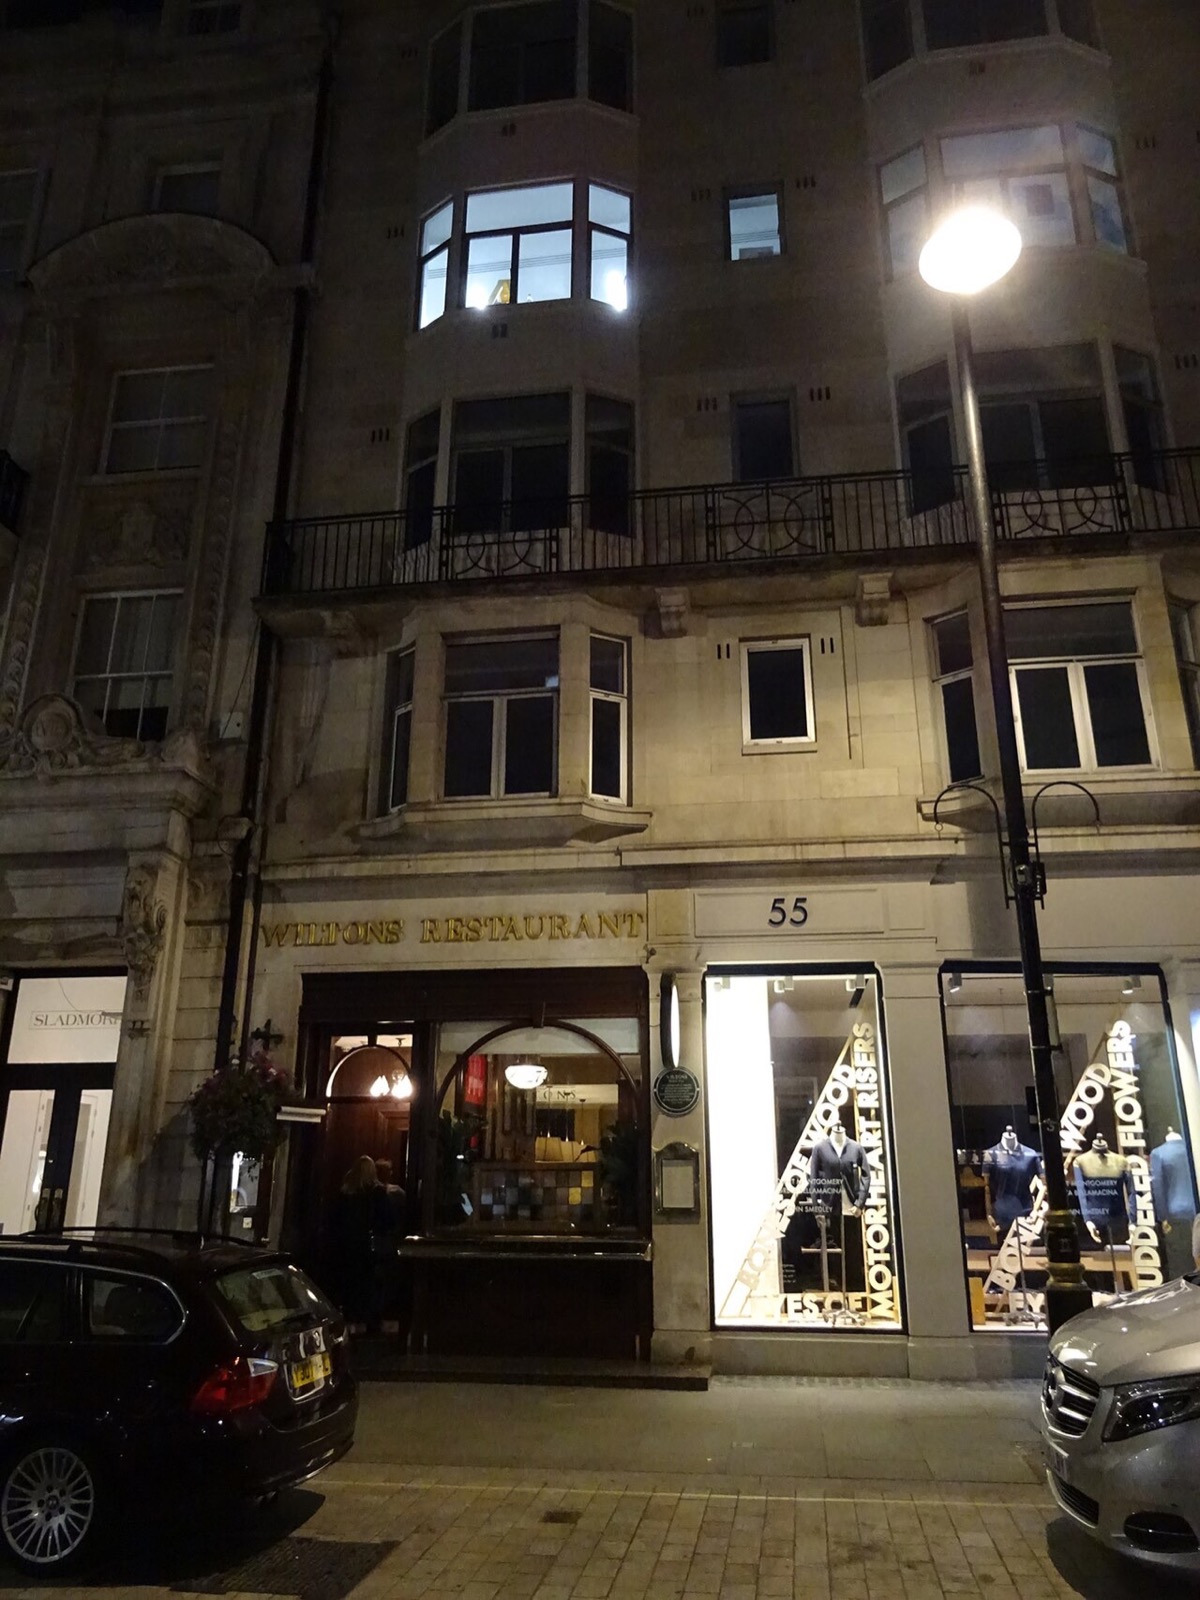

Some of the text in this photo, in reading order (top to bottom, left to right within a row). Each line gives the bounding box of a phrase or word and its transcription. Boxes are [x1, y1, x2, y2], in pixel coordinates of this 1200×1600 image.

[261, 912, 644, 947] WILTONS RESTAURANT
[768, 897, 808, 928] 55
[800, 1063, 856, 1148] WOOD
[1059, 1063, 1112, 1151] WOOD
[1106, 1020, 1146, 1147] FLOWERS
[852, 1022, 896, 1321] MOTORHEART RISERS
